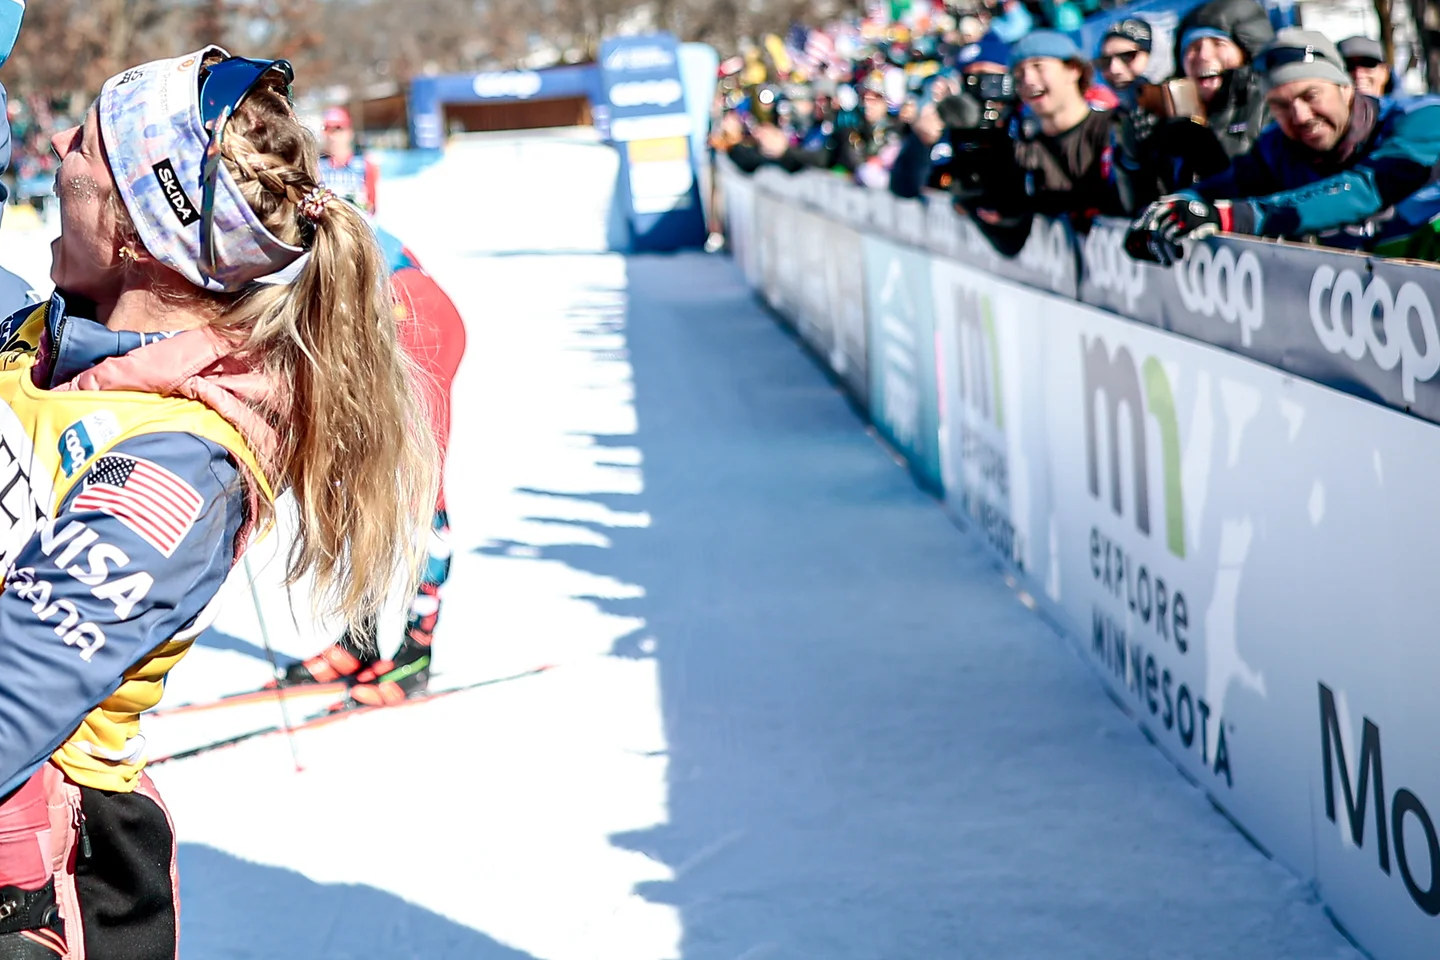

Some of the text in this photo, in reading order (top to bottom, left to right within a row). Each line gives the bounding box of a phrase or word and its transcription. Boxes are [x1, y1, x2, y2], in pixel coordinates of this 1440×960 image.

[157, 167, 193, 221] SKIDA
[1309, 265, 1440, 403] coop
[37, 520, 154, 621] VISA
[1317, 678, 1440, 918] Mo
